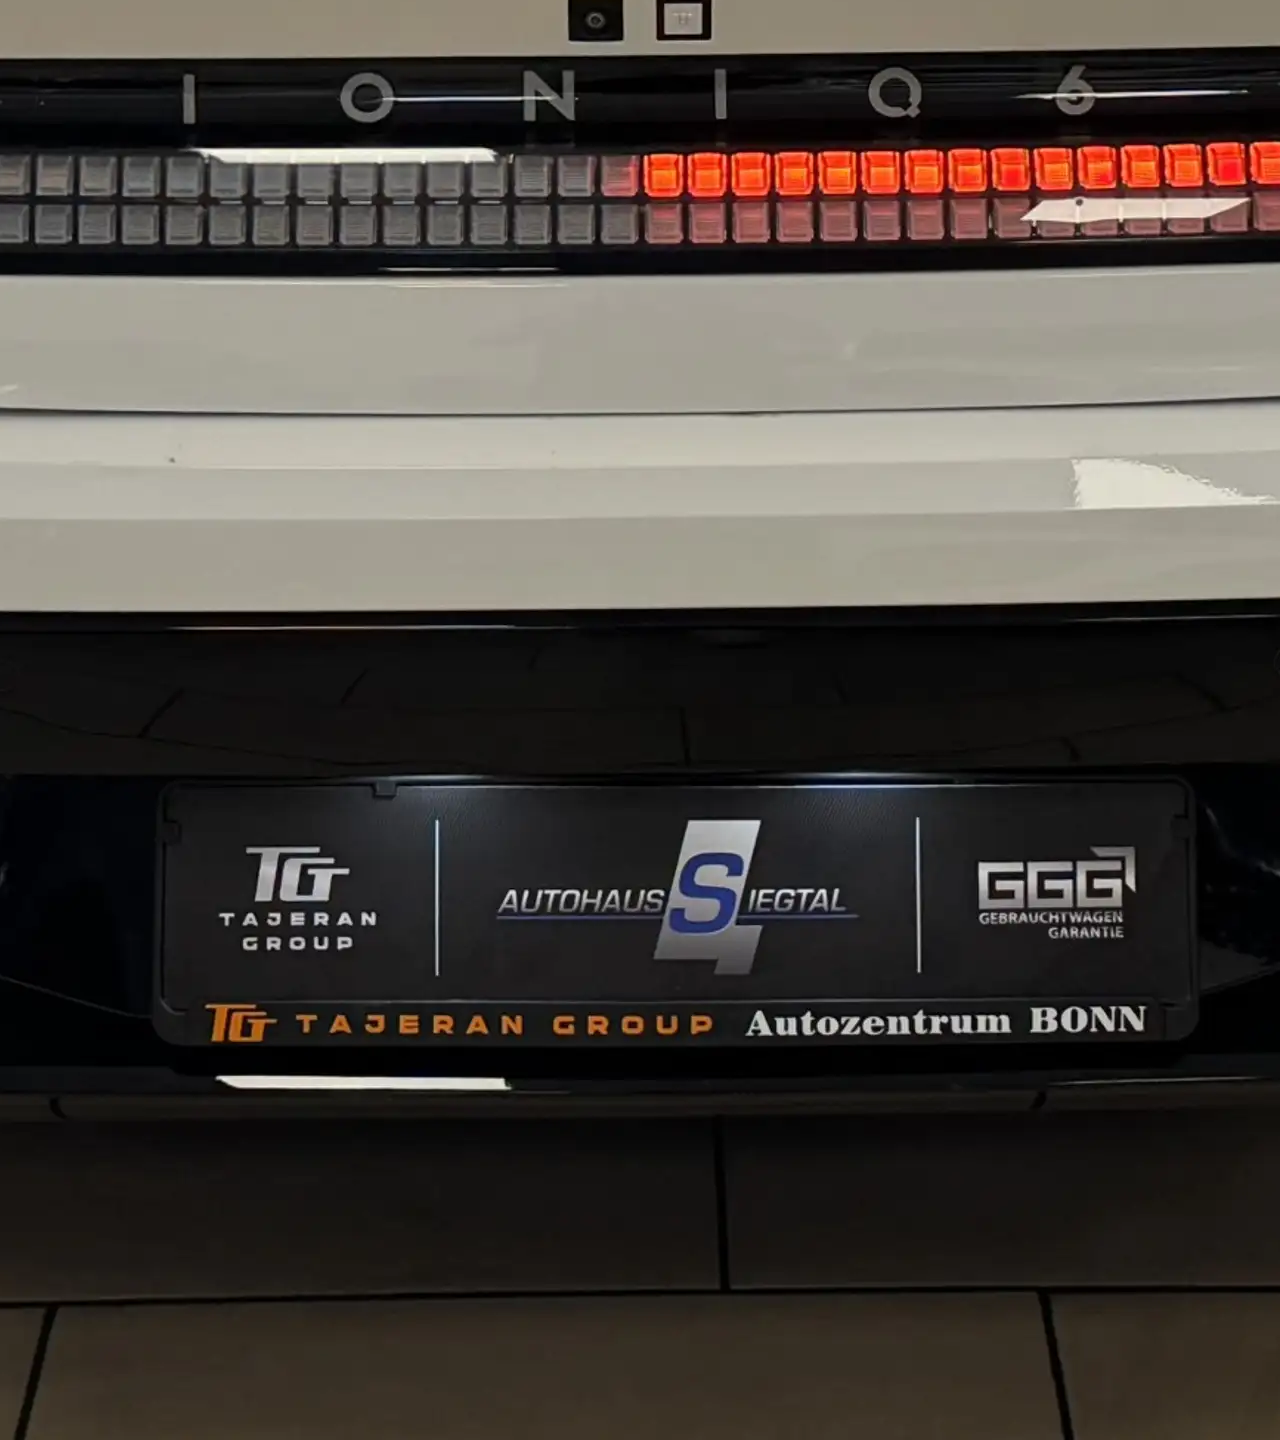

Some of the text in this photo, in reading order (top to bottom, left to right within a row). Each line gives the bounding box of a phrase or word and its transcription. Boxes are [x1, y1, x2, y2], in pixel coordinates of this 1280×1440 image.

[182, 64, 1095, 125] IONIQ 6
[977, 859, 1124, 909] GGG
[498, 888, 665, 913] AUTOHAUS
[218, 911, 377, 927] TAJERAN
[978, 911, 1124, 925] GEBRAUCHTWAGEN
[1047, 926, 1125, 939] GARANTIE
[242, 936, 354, 951] GROUP
[297, 1014, 525, 1037] TAJERAN
[553, 1013, 714, 1036] GROUP
[744, 1008, 1012, 1037] Autozentrum
[1030, 1005, 1147, 1034] BONN
